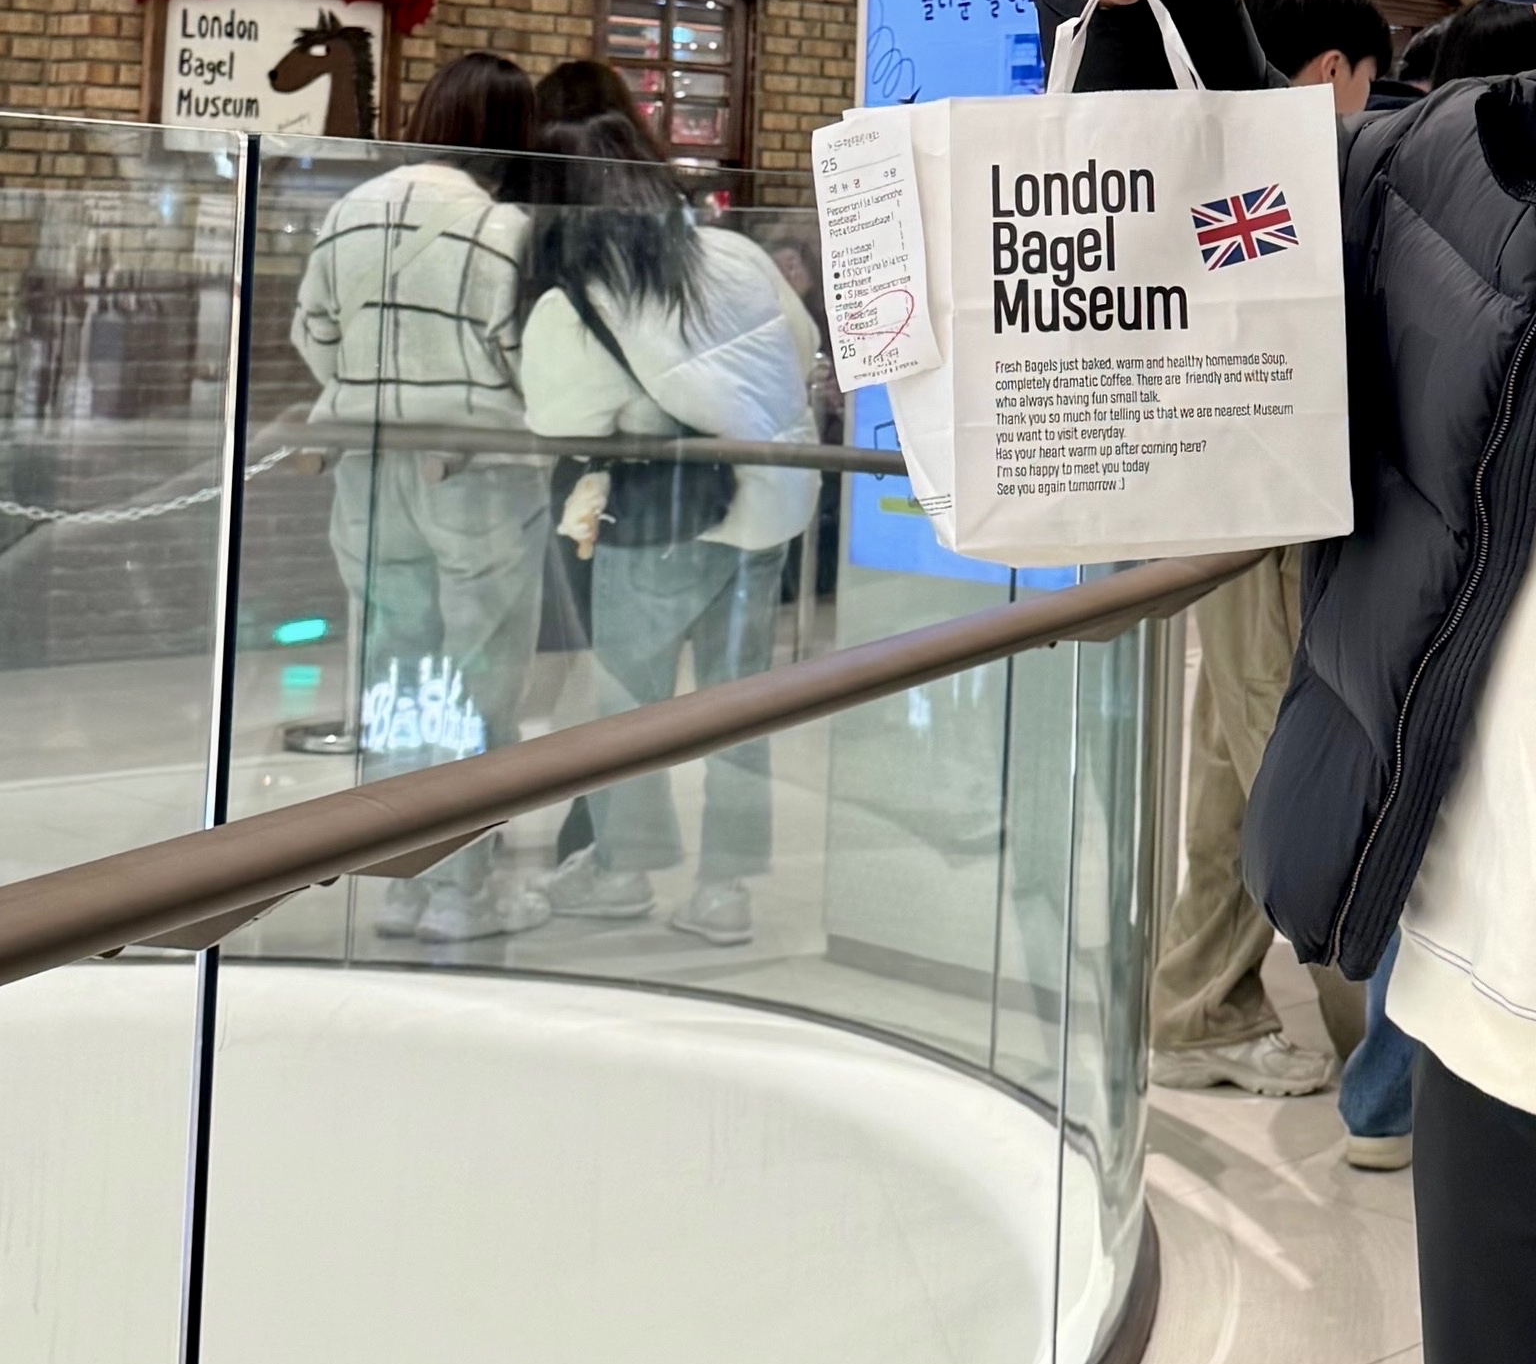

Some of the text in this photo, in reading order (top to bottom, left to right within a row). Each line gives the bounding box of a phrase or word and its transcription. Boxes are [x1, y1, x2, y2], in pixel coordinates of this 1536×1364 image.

[181, 8, 259, 42] London
[178, 48, 235, 86] Bagel
[176, 87, 260, 119] Museum
[821, 157, 838, 174] 25
[992, 159, 1155, 218] London
[993, 216, 1115, 287] Bagel
[993, 279, 1188, 334] Museum
[840, 343, 857, 360] 25
[995, 360, 1022, 374] Fresh
[1025, 359, 1058, 375] Bagels
[1059, 358, 1079, 373] just
[1116, 359, 1144, 370] warm
[1147, 357, 1164, 369] and
[1167, 355, 1203, 369] healthy
[1206, 354, 1260, 366] homemade
[995, 377, 1051, 392] completely
[1053, 376, 1098, 389] dramatic
[1137, 374, 1163, 386] There
[1165, 374, 1181, 385] are
[1185, 372, 1222, 384] friendly
[1224, 370, 1242, 383] and
[1244, 370, 1269, 383] witty
[1270, 368, 1293, 382] staff
[995, 391, 1161, 409] who always having fun small talk.
[996, 404, 1294, 426] Thank you so much for telling us that we are nearest Museum
[996, 432, 1014, 445] you
[1016, 429, 1042, 442] want
[1045, 428, 1055, 441] to
[1057, 427, 1078, 440] visit
[995, 440, 1207, 461] Has your heart warm up after coming here?
[1015, 466, 1027, 477] so
[1029, 464, 1059, 478] happy
[1062, 463, 1072, 475] to
[1074, 461, 1100, 474] meet
[1101, 461, 1119, 475] you
[1122, 460, 1150, 474] today
[997, 483, 1015, 496] See
[1017, 484, 1035, 497] you
[1038, 481, 1066, 496] again
[1068, 479, 1117, 492] tomorrow
